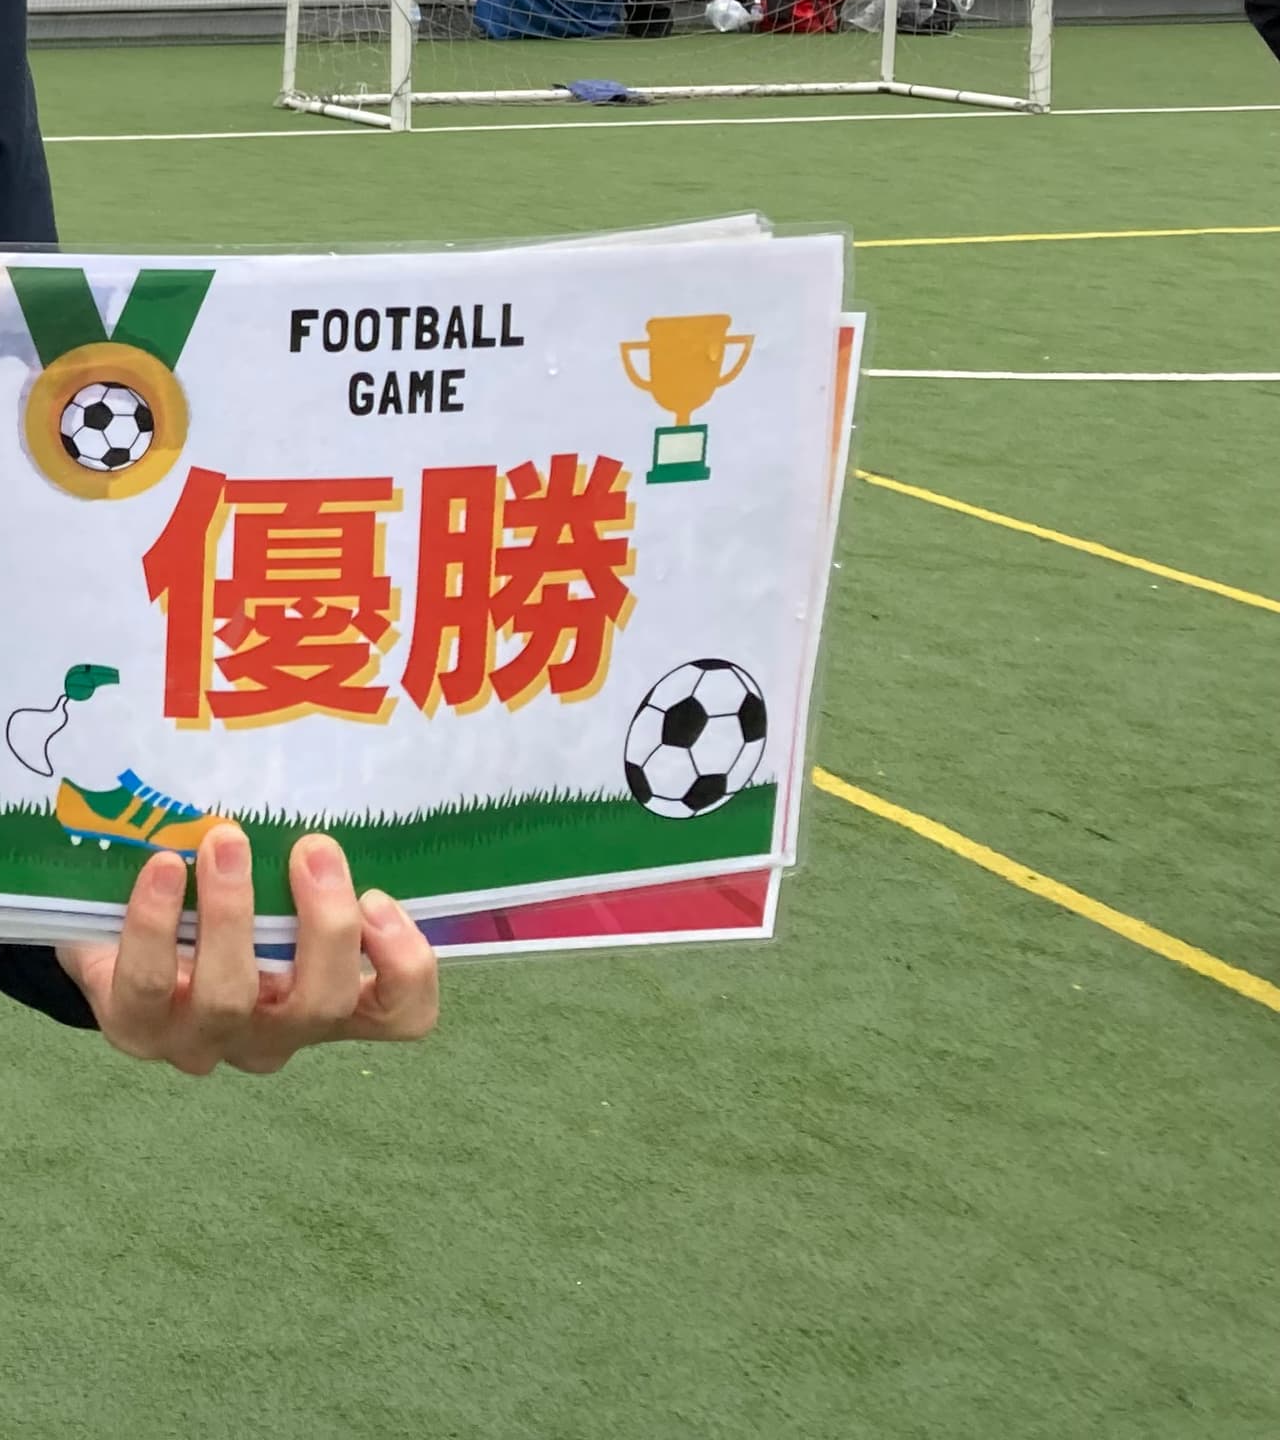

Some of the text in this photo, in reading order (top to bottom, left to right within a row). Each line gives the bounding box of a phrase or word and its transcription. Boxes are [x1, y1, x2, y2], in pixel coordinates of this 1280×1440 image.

[289, 303, 525, 353] FOOTBALL
[347, 369, 465, 416] GAME
[142, 453, 637, 730] 優勝
